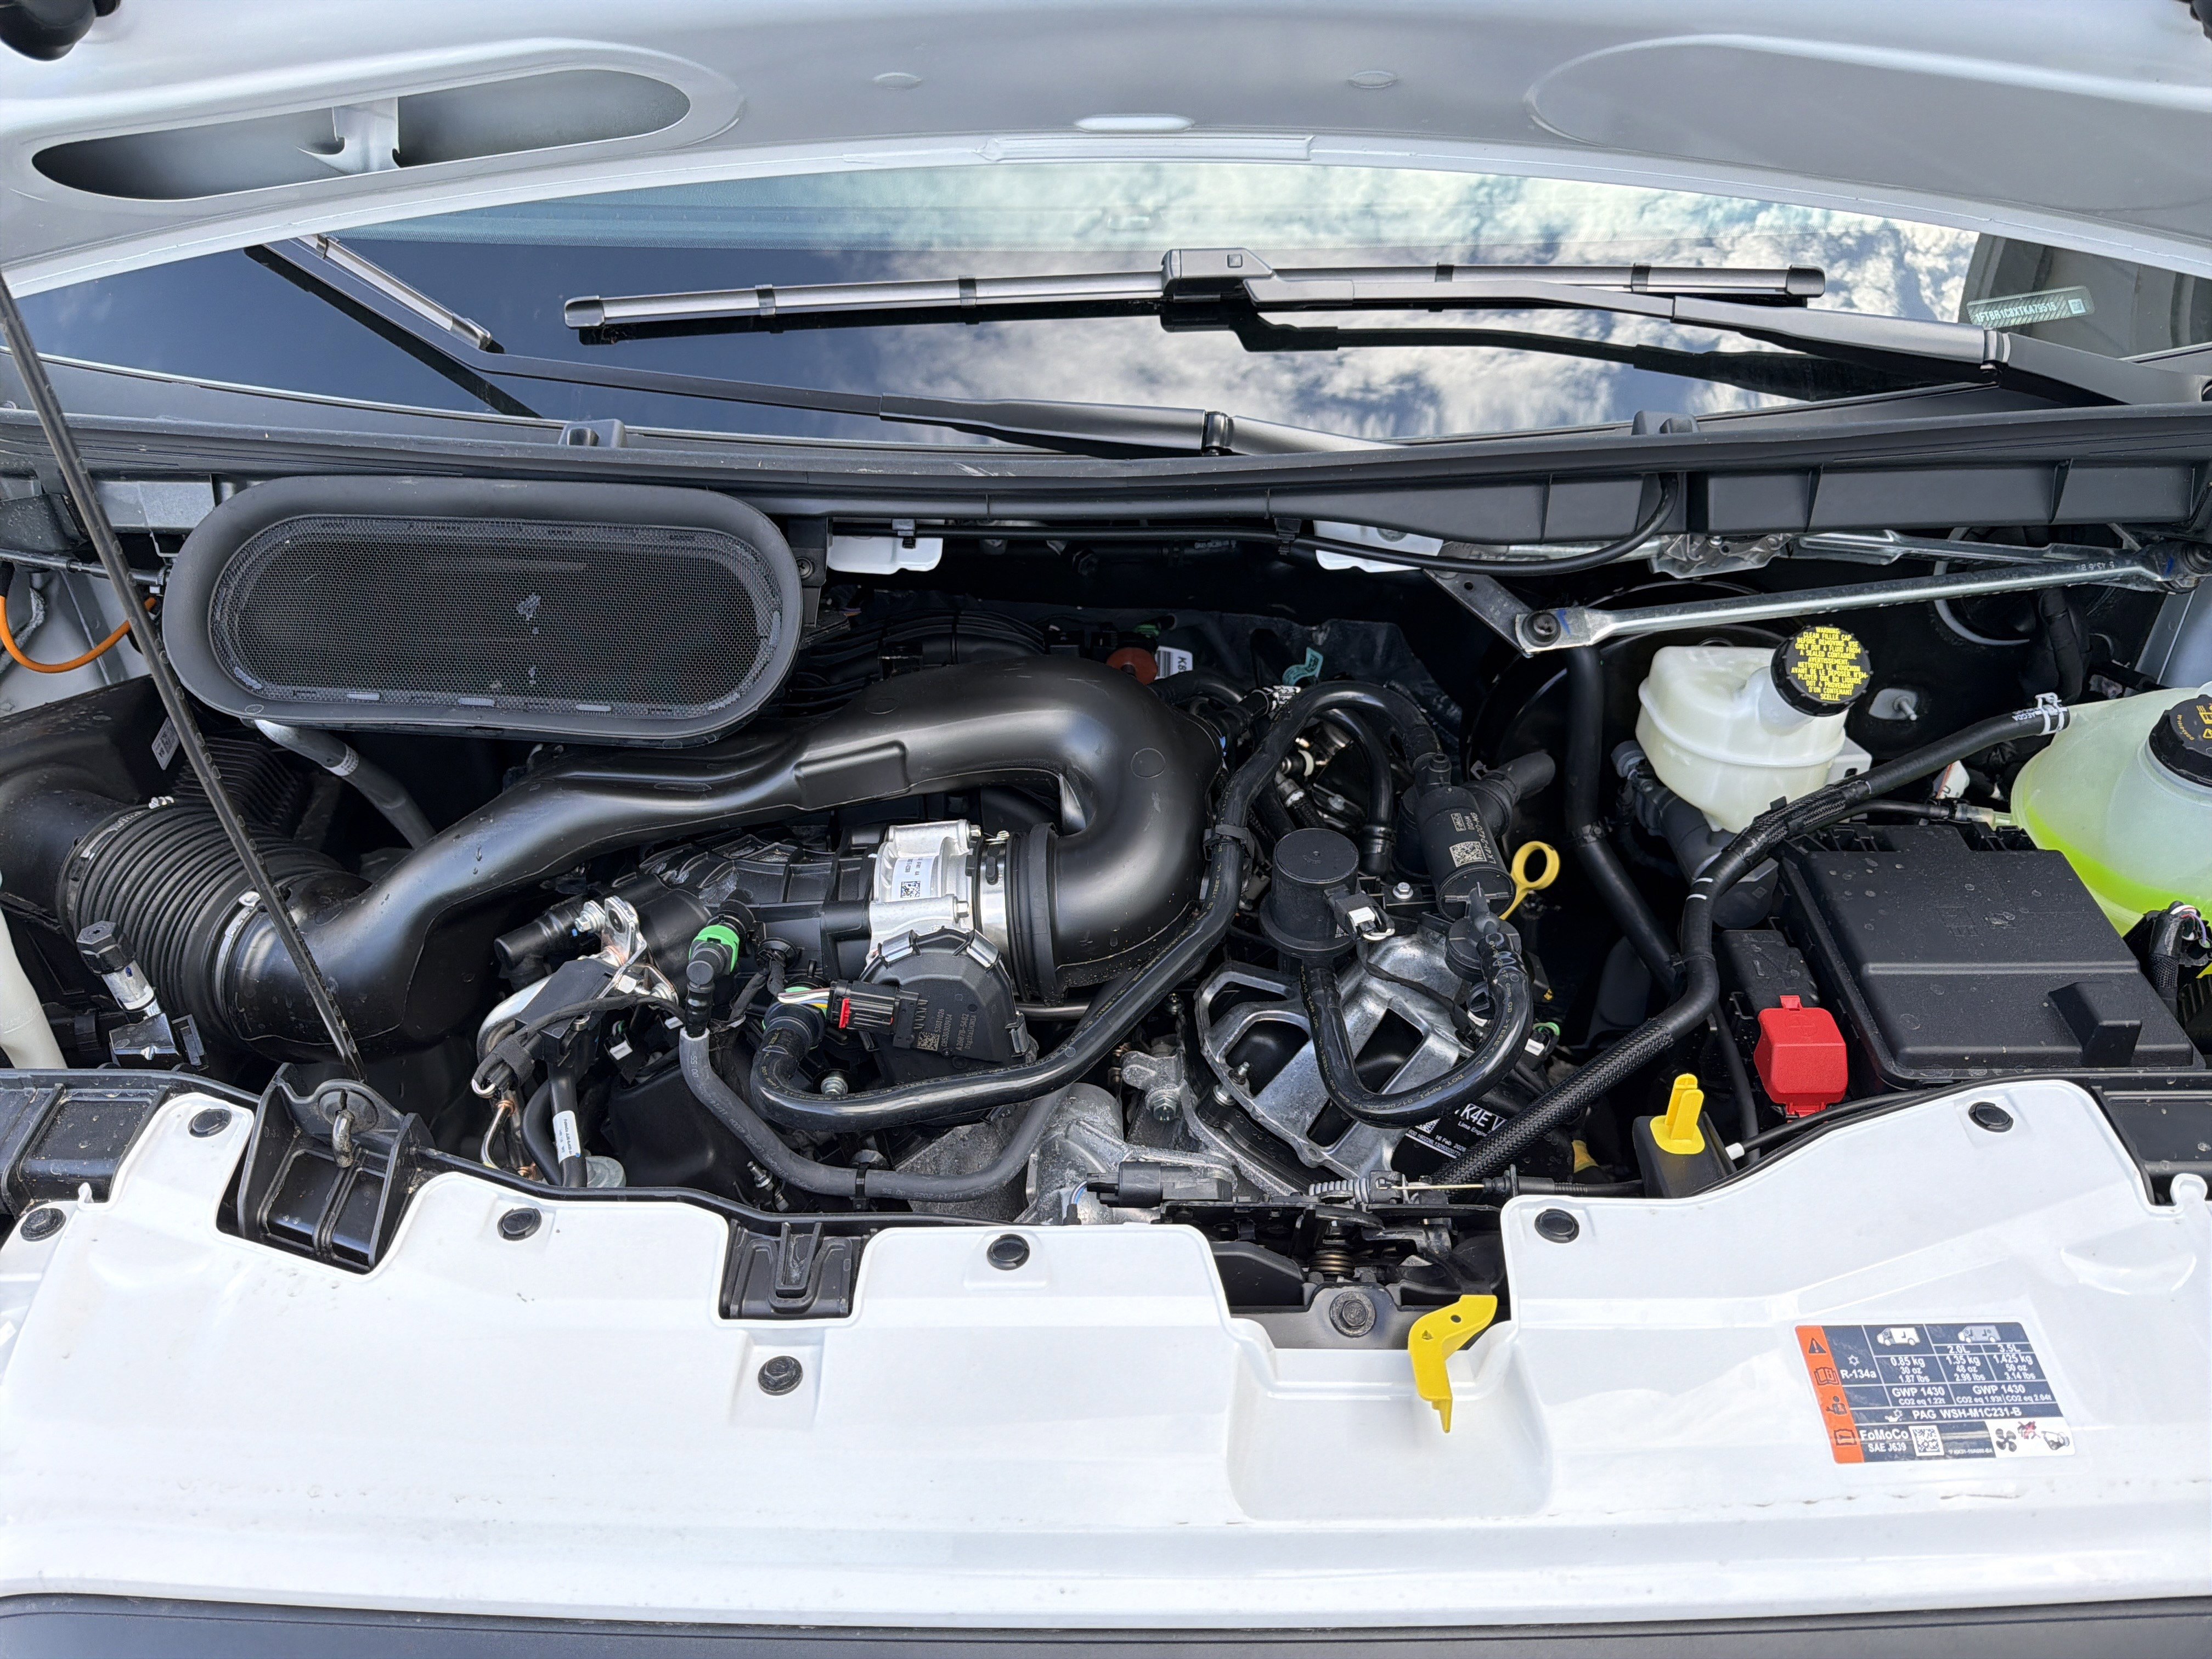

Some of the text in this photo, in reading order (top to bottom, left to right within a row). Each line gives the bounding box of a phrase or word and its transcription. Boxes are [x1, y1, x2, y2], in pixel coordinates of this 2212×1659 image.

[1976, 302, 2056, 322] 1FTBR1C8XTKA79515
[1824, 681, 1854, 690] PROVENANT
[1823, 687, 1852, 696] CONTENANT
[1447, 1074, 1465, 1088] DOT
[1441, 1137, 1452, 1146] Feb
[1947, 1344, 2021, 1354] 2.0L 3.5L
[1890, 1356, 1926, 1368] 0.85 kg
[1946, 1355, 1981, 1366] 1.35 kg
[1993, 1353, 2033, 1365] 1.425 kg
[1900, 1366, 1910, 1374] 30
[2005, 1363, 2016, 1372] 50
[1840, 1369, 1877, 1379] R-134a
[1899, 1375, 1915, 1383] 1.87
[1954, 1373, 1971, 1382] 2.98
[2004, 1372, 2022, 1380] 3.14
[1892, 1386, 1945, 1397] GWP 1430
[1972, 1384, 2025, 1395] GWP 1430
[1912, 1407, 2022, 1420] PAG WSH-M1C231-B
[1859, 1429, 1909, 1441] FoMoCo
[1868, 1442, 1907, 1453] SAE J639
